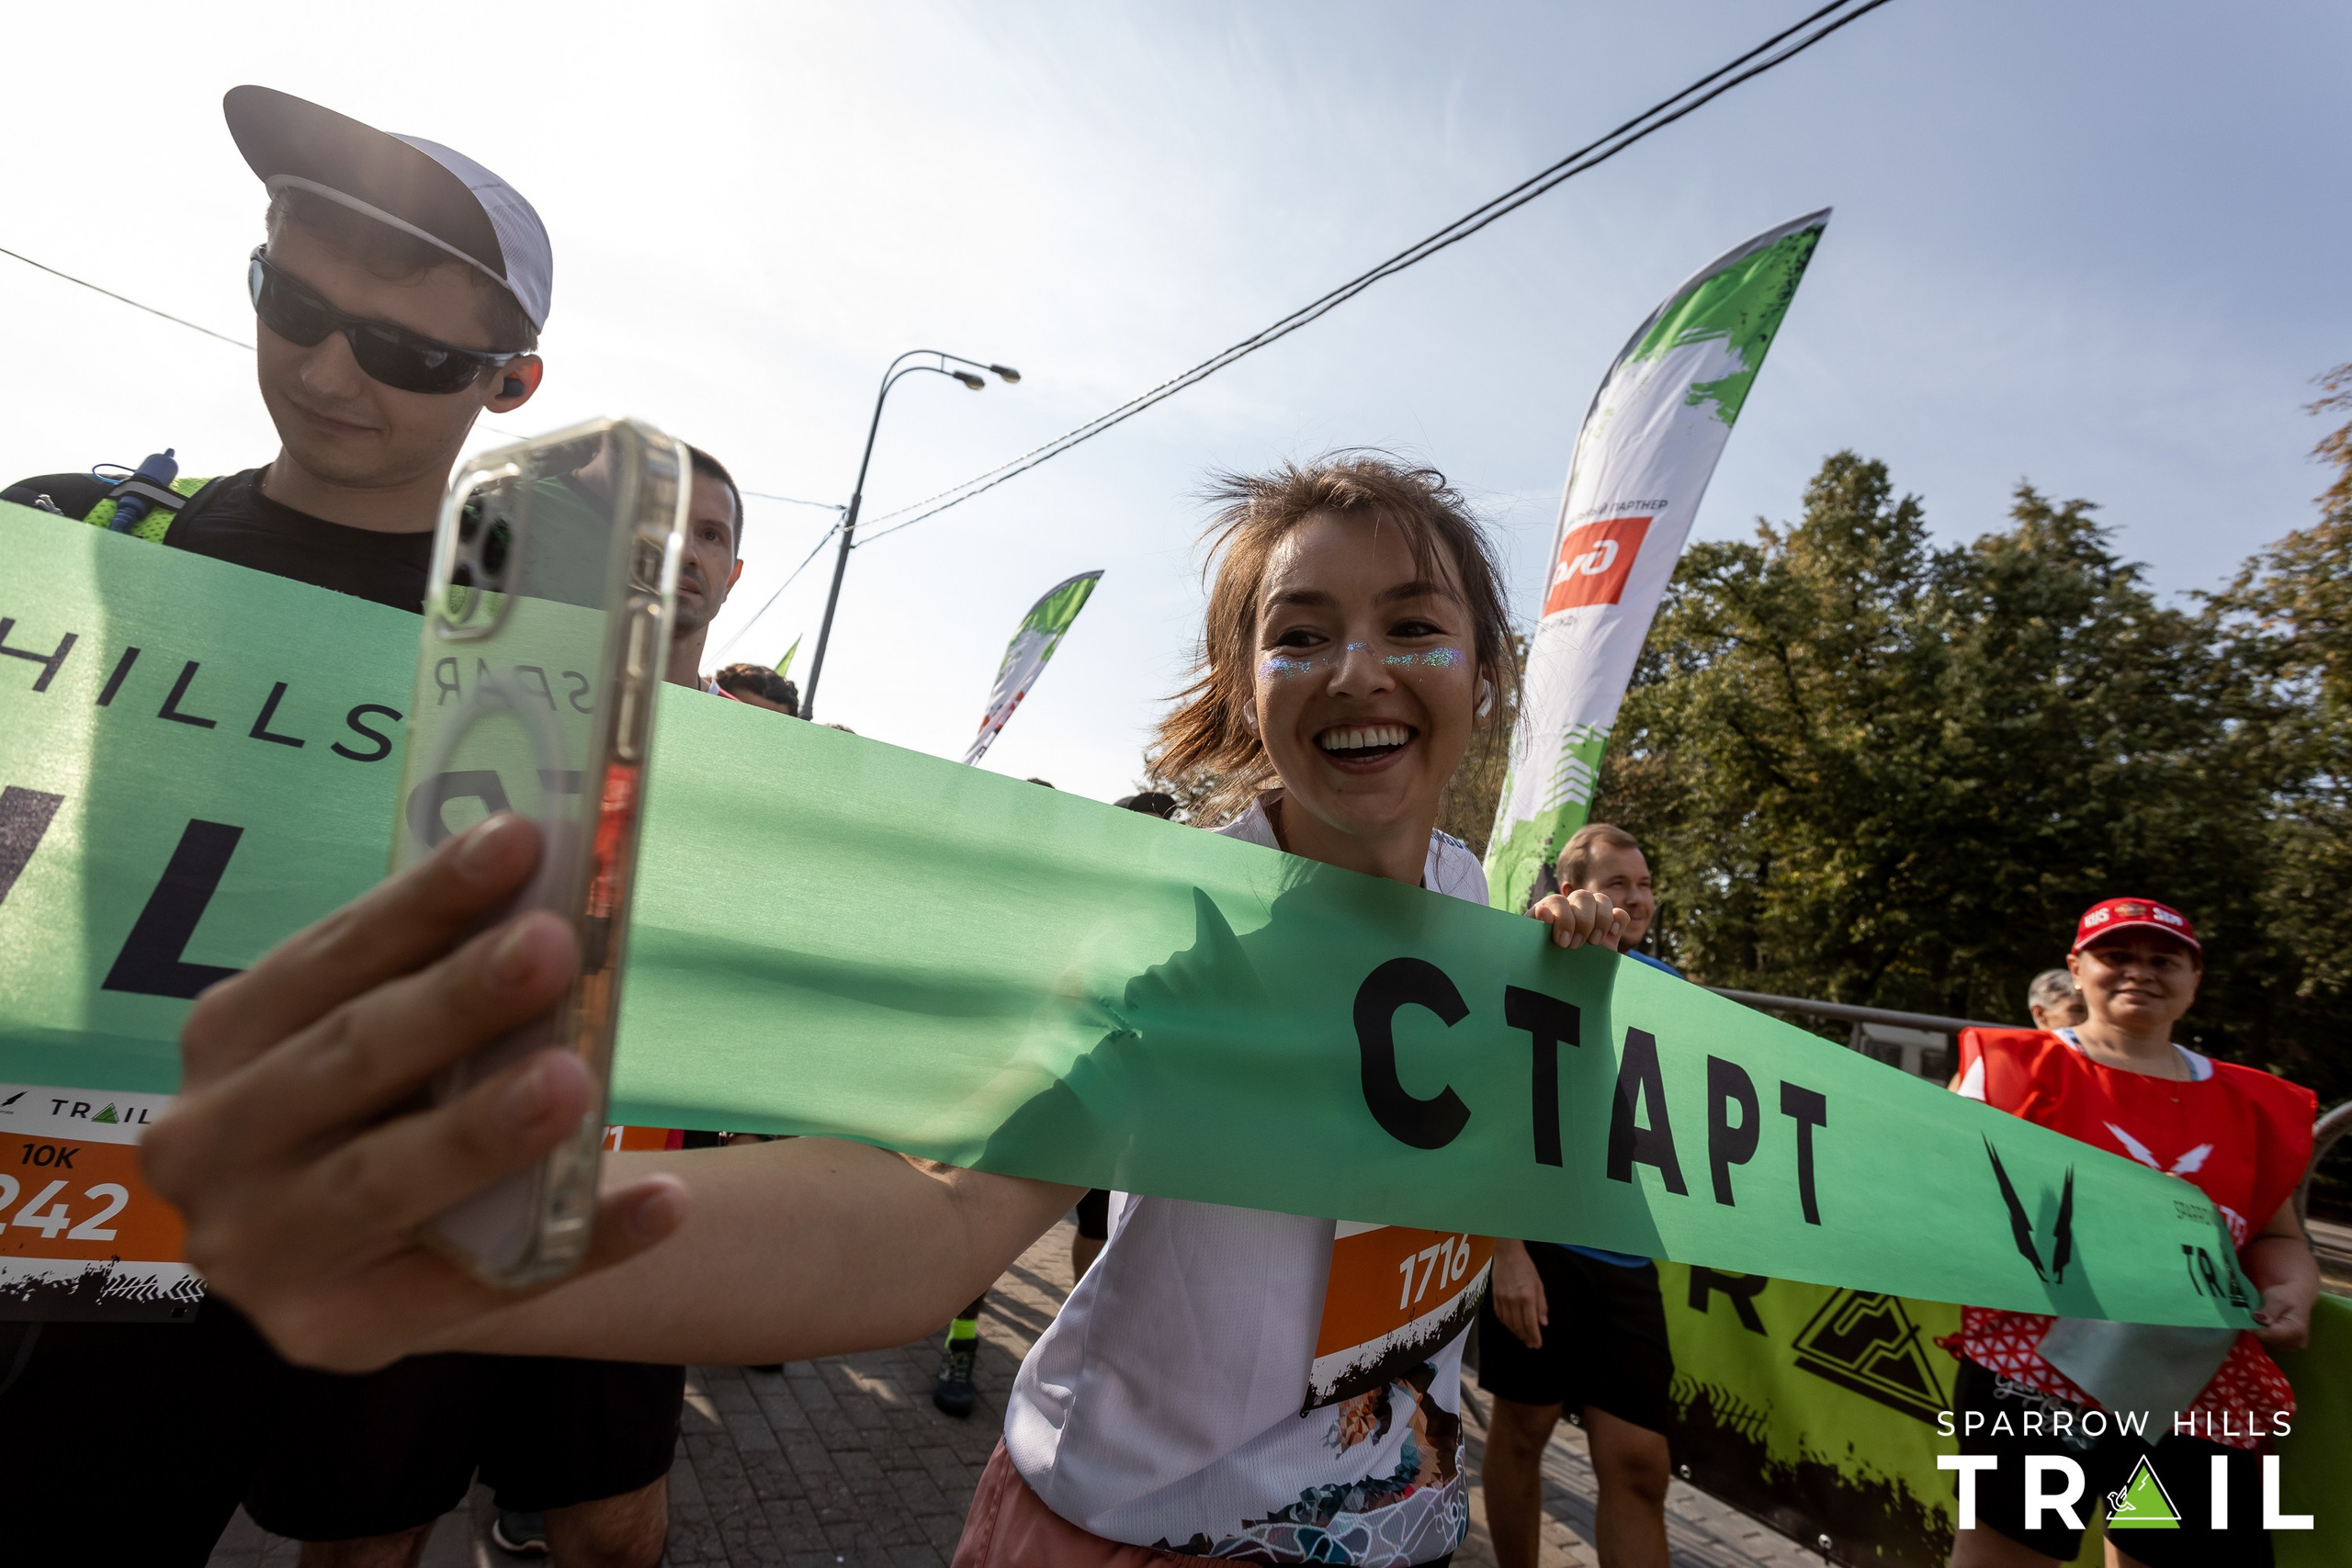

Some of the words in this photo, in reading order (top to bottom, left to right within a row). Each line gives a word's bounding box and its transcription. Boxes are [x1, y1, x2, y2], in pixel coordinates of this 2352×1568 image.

[1610, 499, 1668, 513] ПАРТНЕР
[0, 617, 404, 762] HILLS
[1353, 957, 1827, 1226] СТАРТ
[21, 1144, 81, 1169] 10K
[1399, 1233, 1471, 1311] 1716
